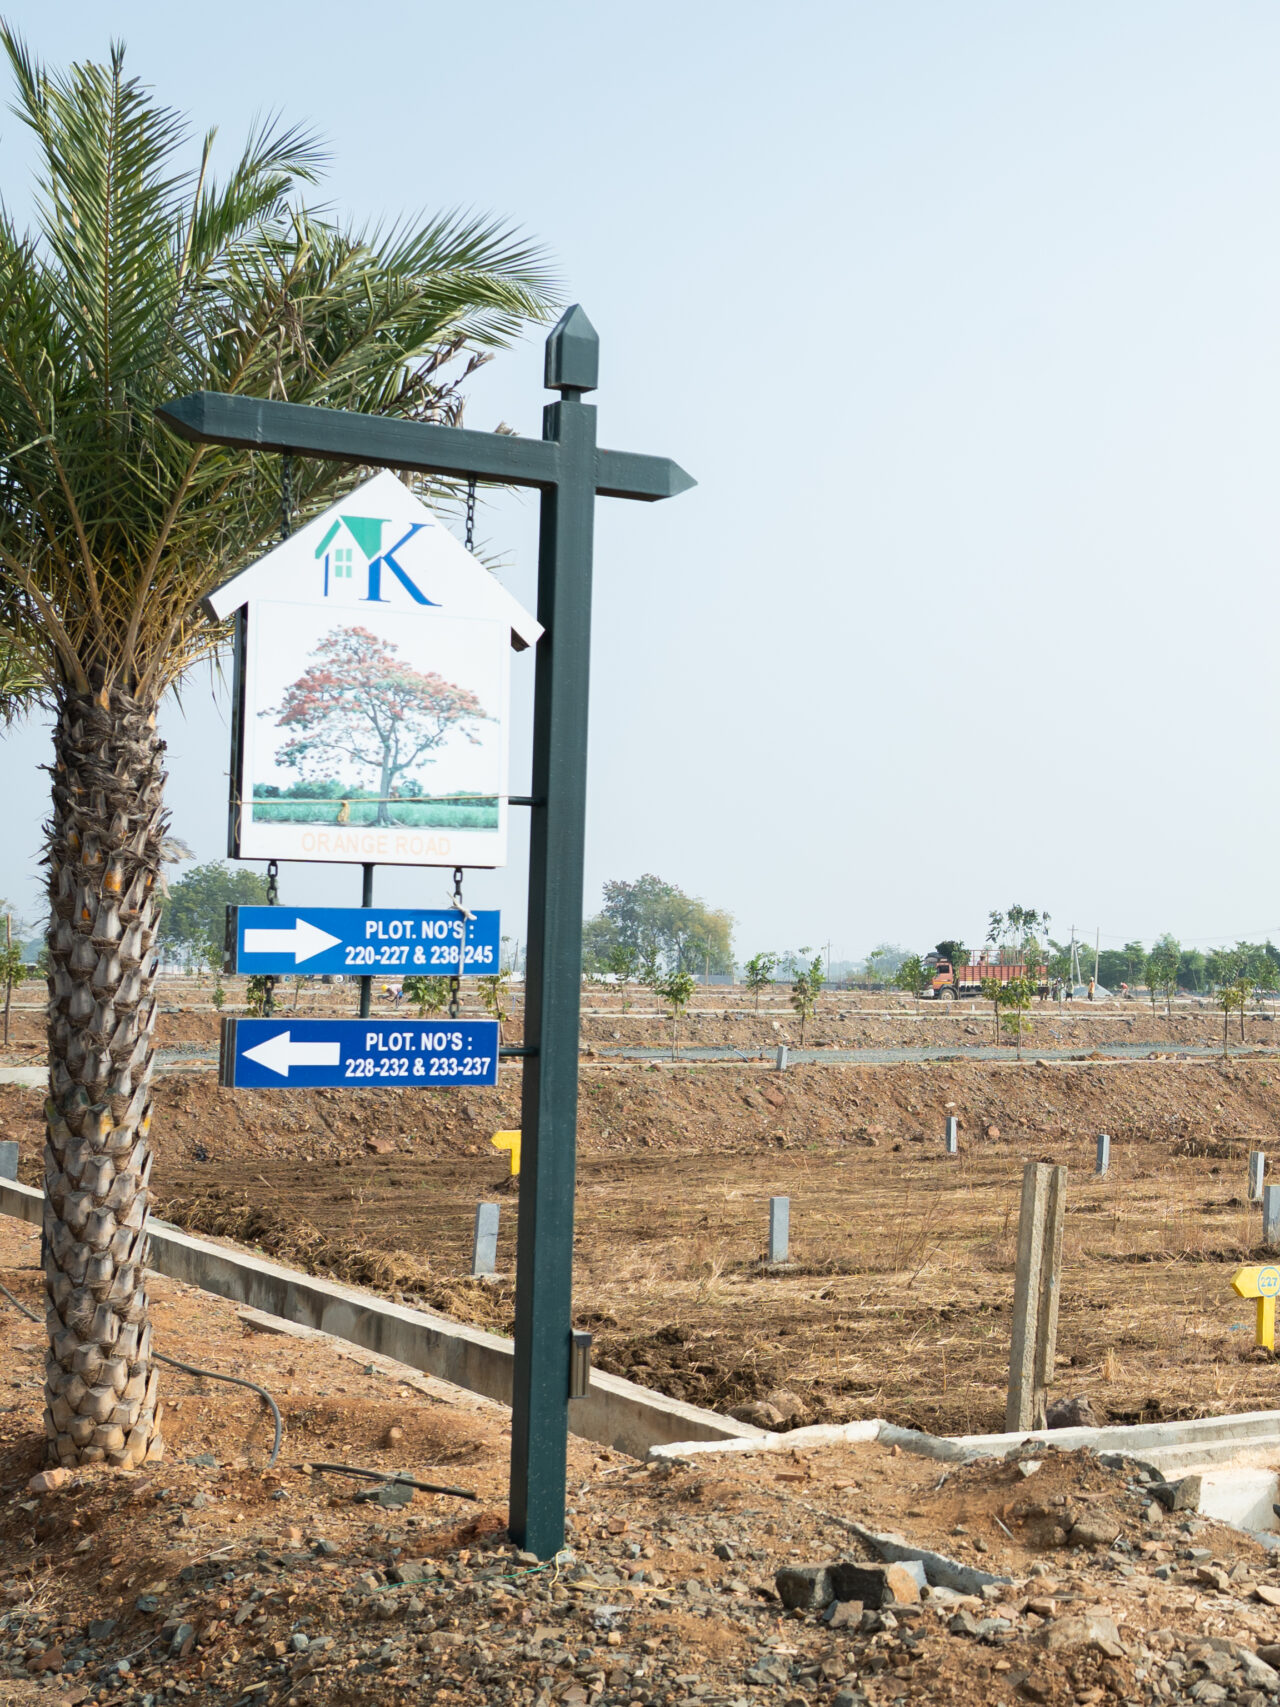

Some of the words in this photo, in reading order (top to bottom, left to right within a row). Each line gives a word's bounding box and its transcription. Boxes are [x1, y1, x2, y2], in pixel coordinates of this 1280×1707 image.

[301, 832, 389, 856] ORANGE
[395, 835, 451, 857] ROAD
[365, 920, 417, 940] PLOT.
[344, 946, 409, 966] 220-227
[413, 946, 427, 965] &
[365, 1032, 417, 1052] PLOT.
[344, 1057, 409, 1079] 228-232
[412, 1057, 426, 1077] &
[429, 1056, 491, 1076] 233-237
